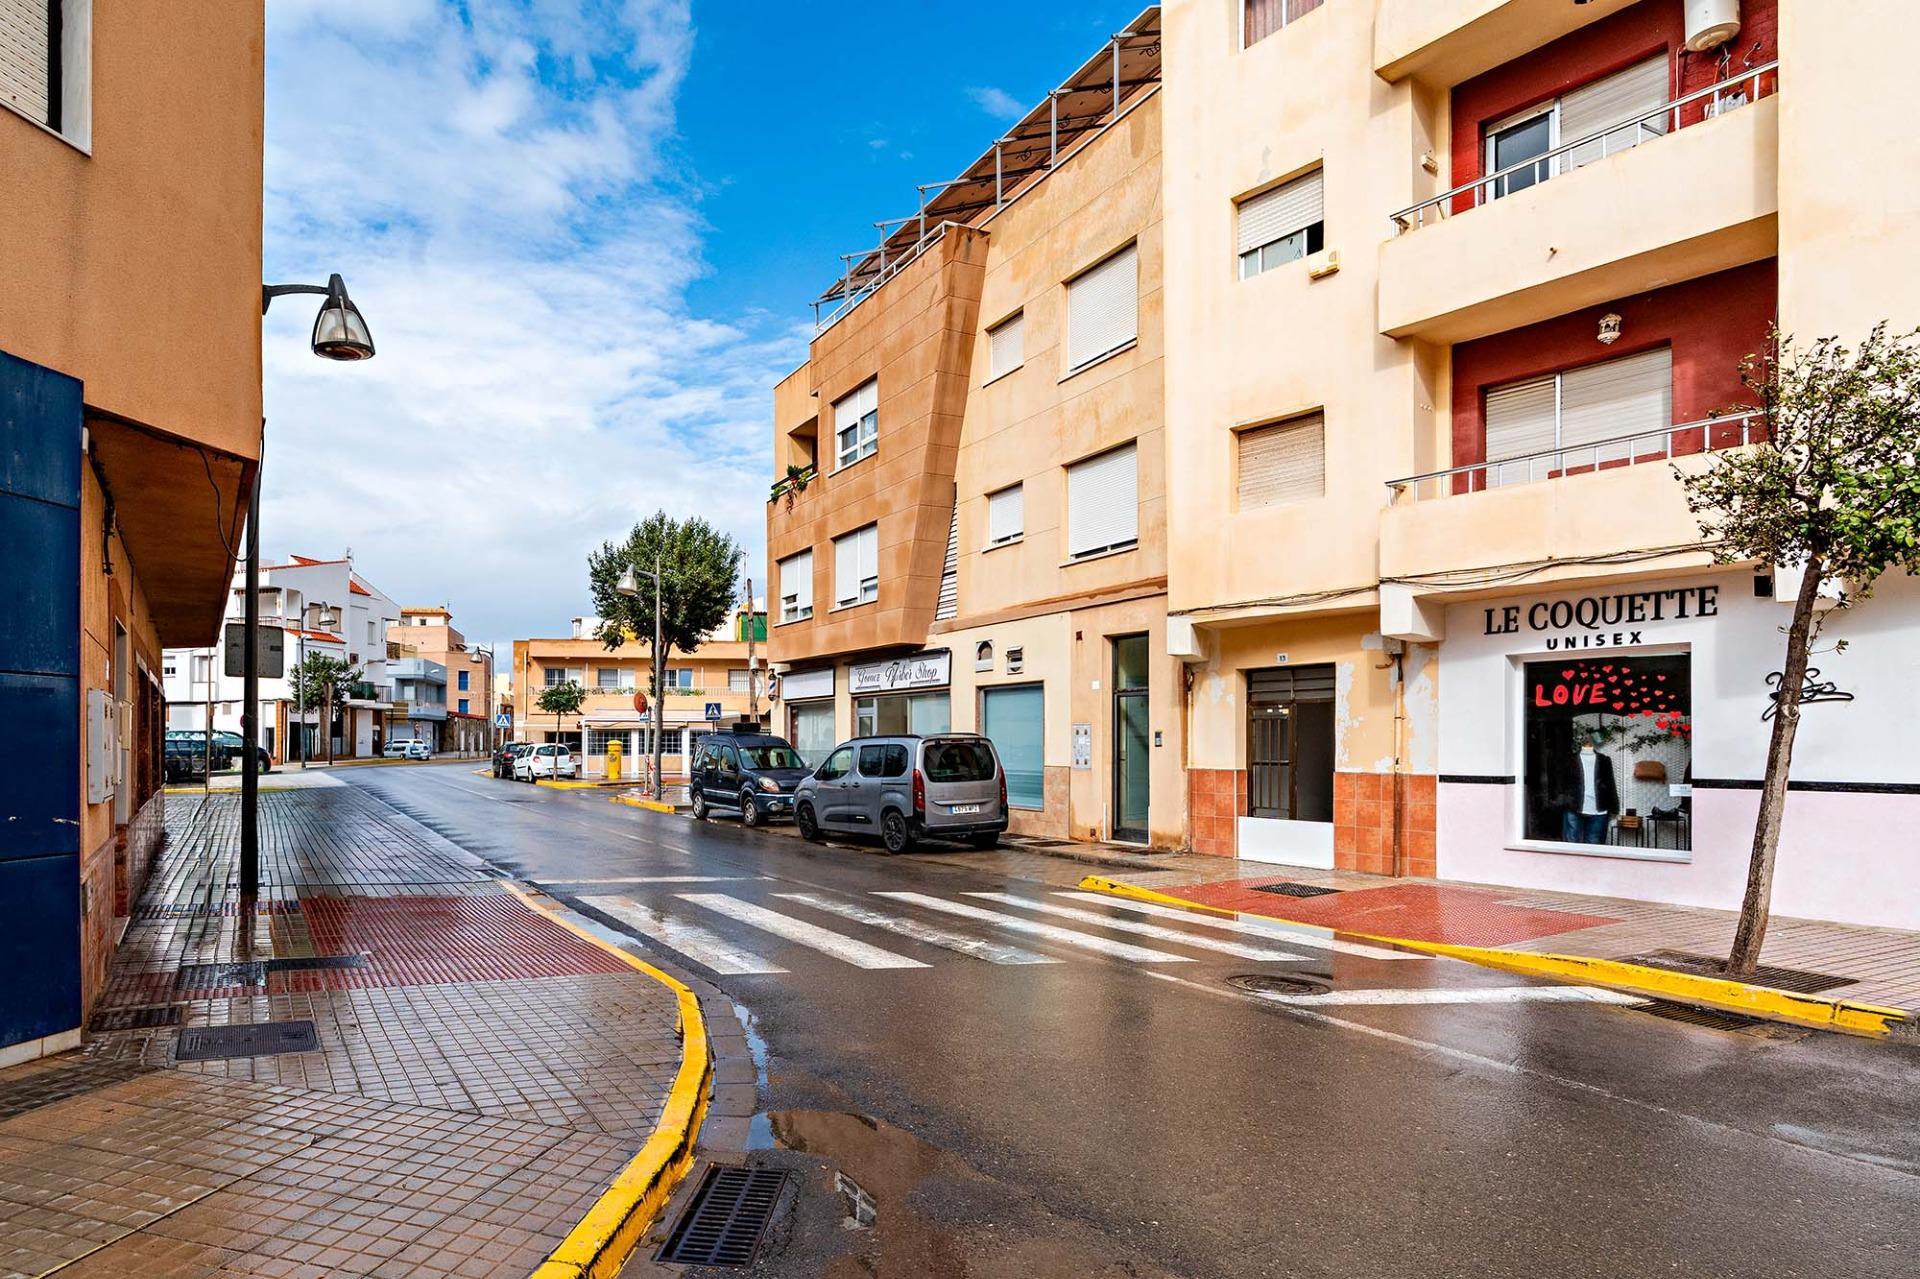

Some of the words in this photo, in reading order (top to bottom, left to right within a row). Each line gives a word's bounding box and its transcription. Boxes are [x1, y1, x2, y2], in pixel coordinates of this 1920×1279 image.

[1484, 606, 1520, 635] LE
[1528, 585, 1719, 629] COQUETTE
[1547, 632, 1642, 650] UNISEX
[915, 661, 937, 684] Shop
[1535, 682, 1607, 707] LOVE
